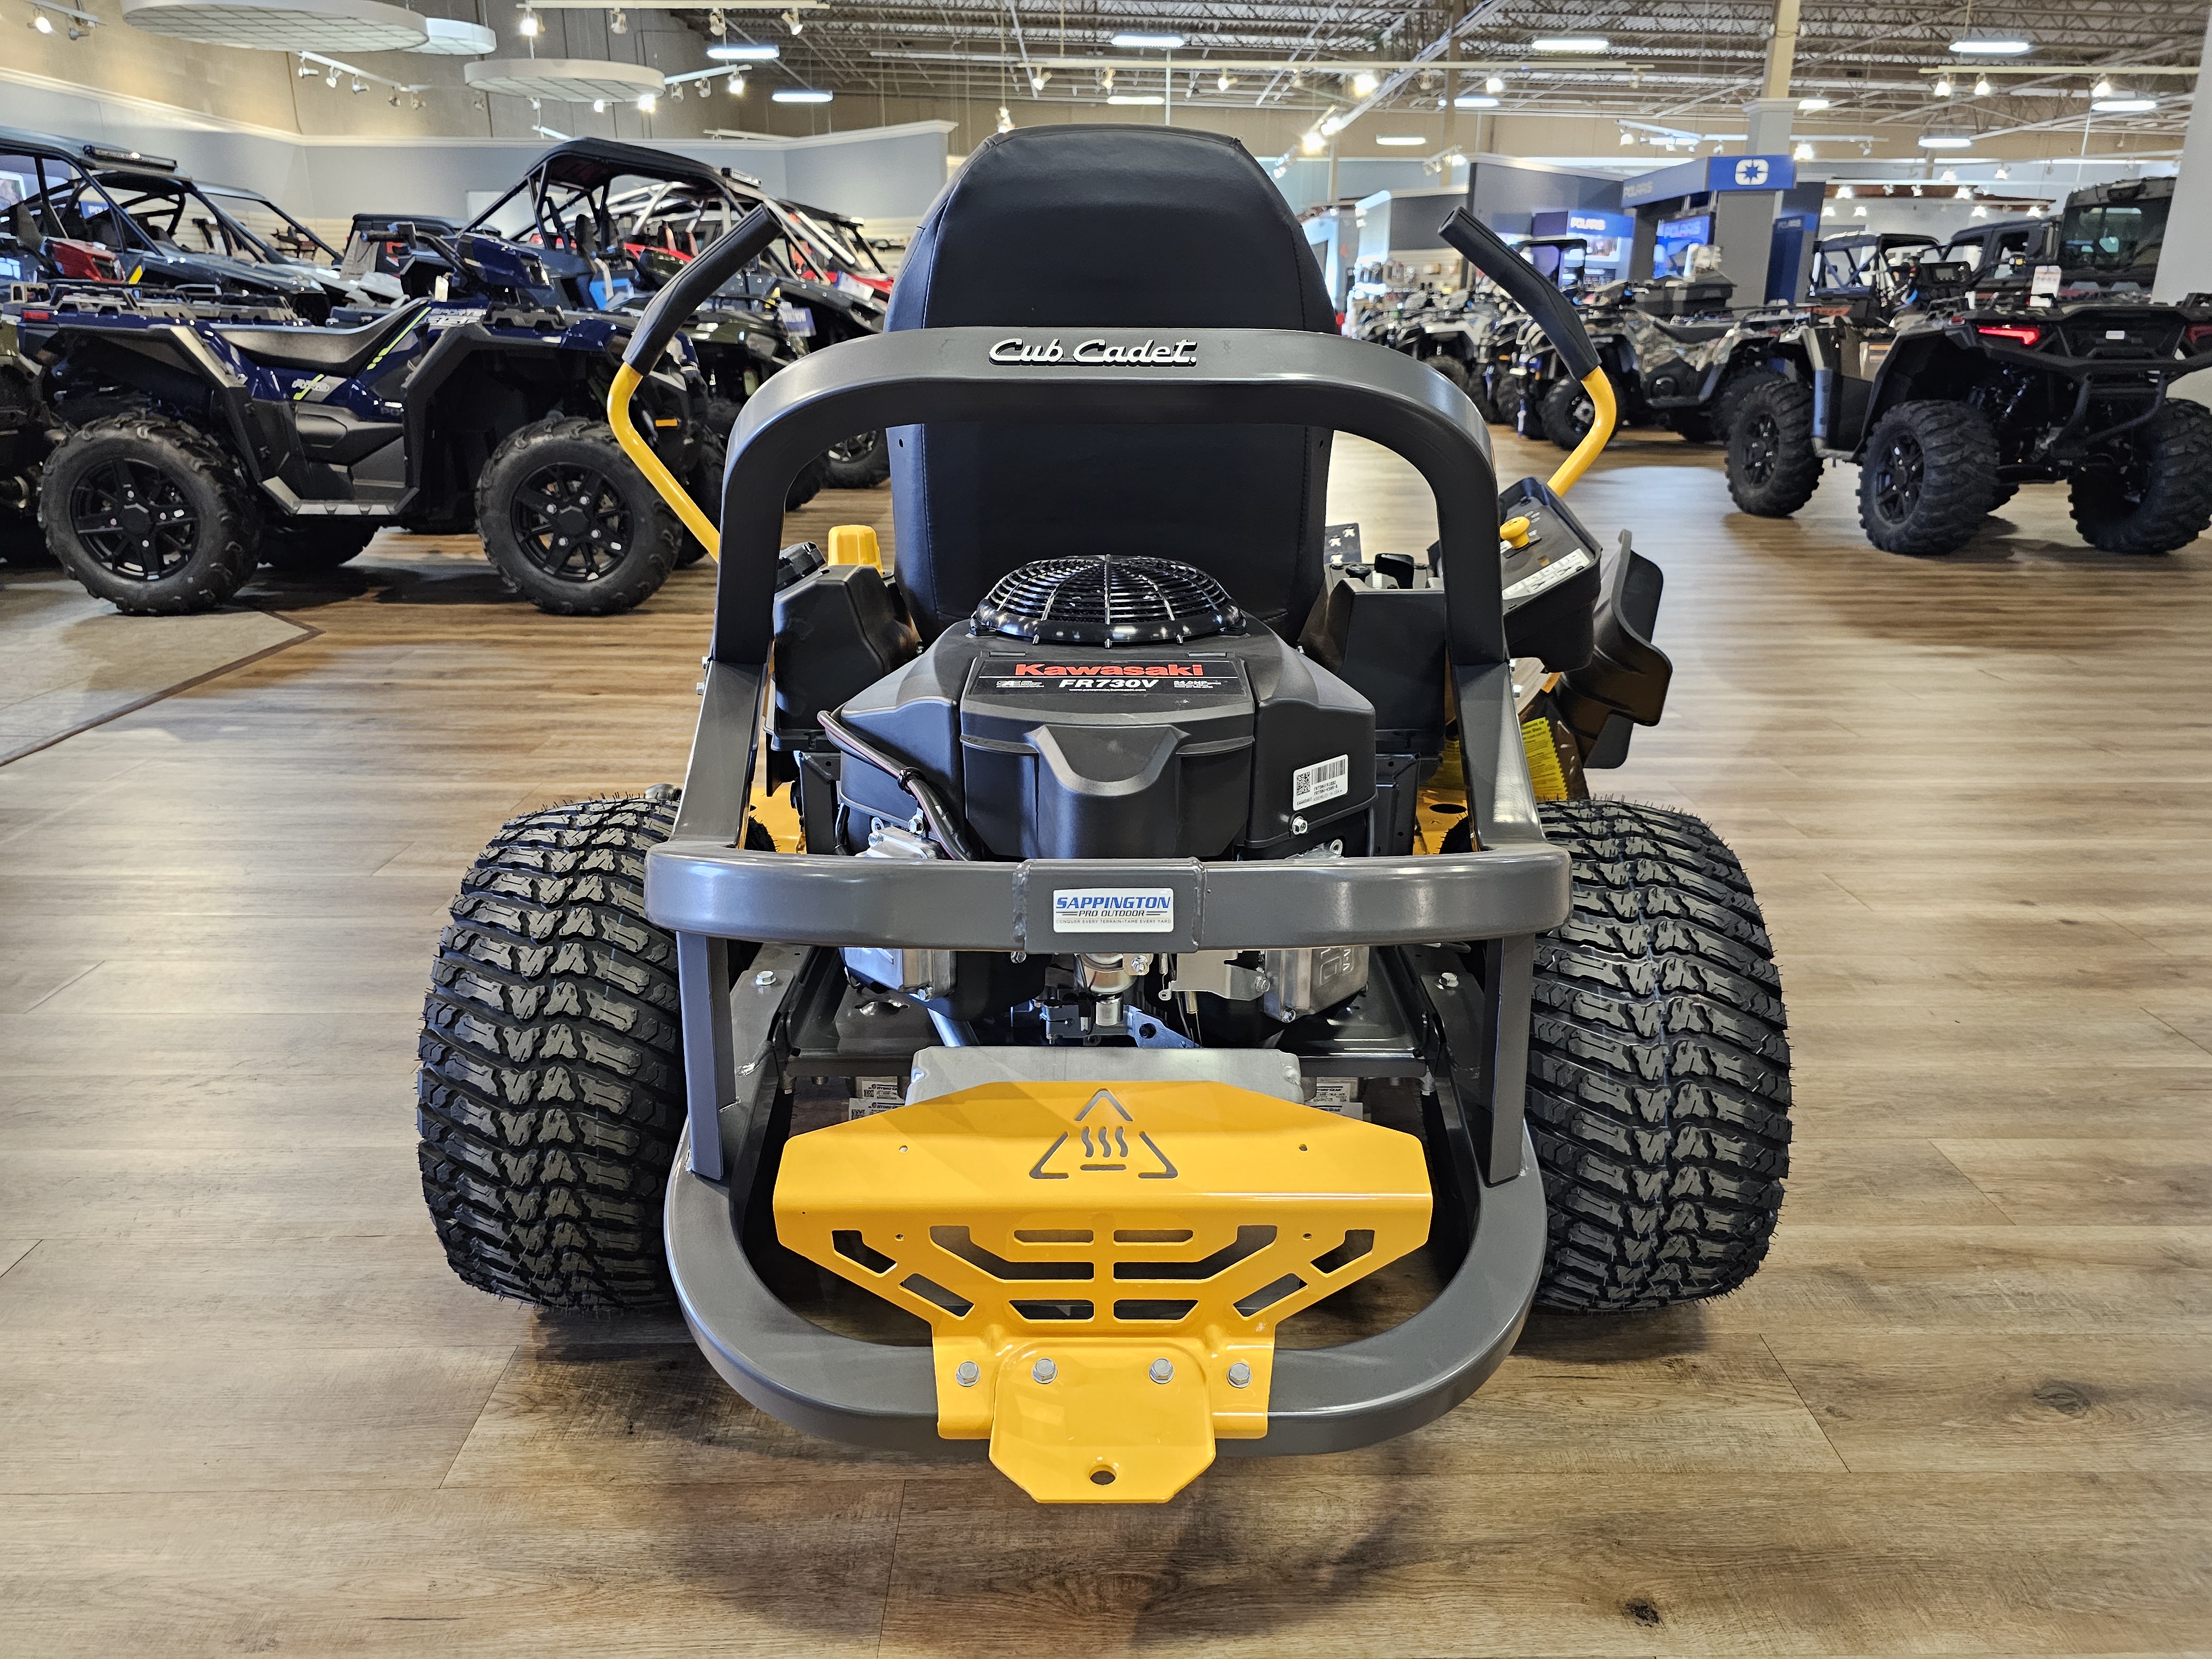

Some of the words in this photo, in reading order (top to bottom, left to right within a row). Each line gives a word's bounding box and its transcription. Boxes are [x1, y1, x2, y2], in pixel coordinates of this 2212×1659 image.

[1571, 217, 1606, 231] POLARIS
[1665, 221, 1702, 238] POLARIS
[989, 338, 1064, 365] Cub
[1015, 664, 1203, 676] Kawasaki
[1058, 679, 1160, 688] FR730V
[1056, 897, 1171, 909] SAPPINGTON
